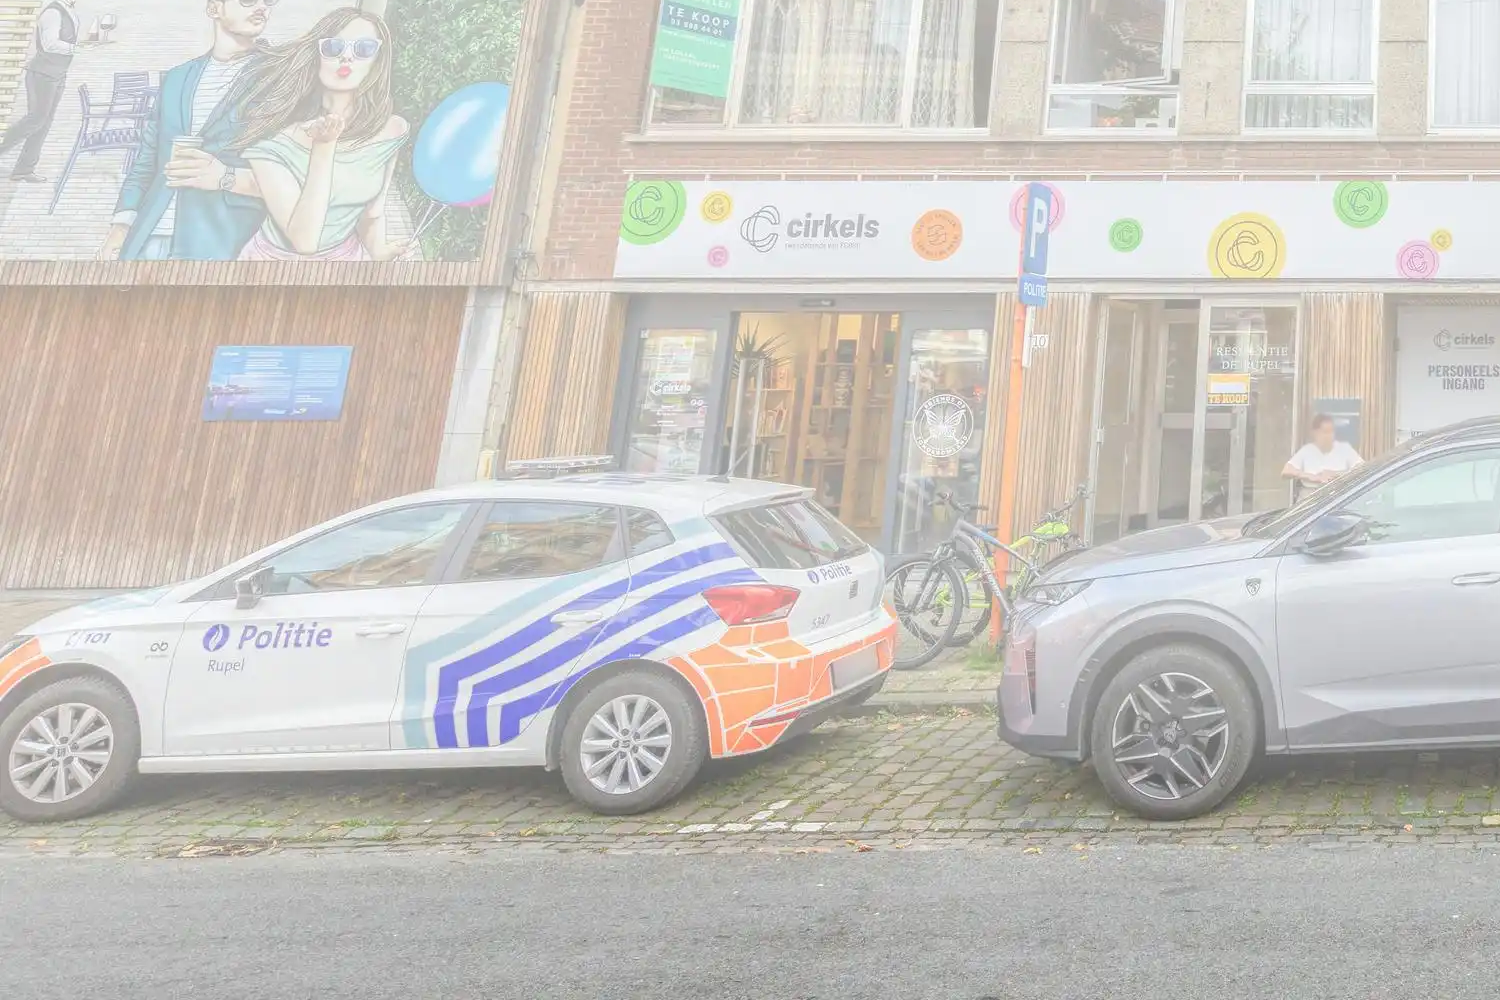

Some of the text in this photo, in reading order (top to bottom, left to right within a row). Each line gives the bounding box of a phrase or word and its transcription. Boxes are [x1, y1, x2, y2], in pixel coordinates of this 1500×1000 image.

[668, 5, 730, 29] TE KOOP
[786, 212, 881, 239] cirkels
[1029, 196, 1048, 258] P
[1453, 332, 1497, 345] cirkels
[1216, 346, 1289, 356] RESENTIE
[1427, 364, 1500, 378] PERSONEELS
[1442, 378, 1486, 391] INGANG
[820, 562, 852, 581] Politie
[84, 632, 112, 645] 101
[238, 621, 333, 650] Politie
[207, 658, 246, 676] Rupel
